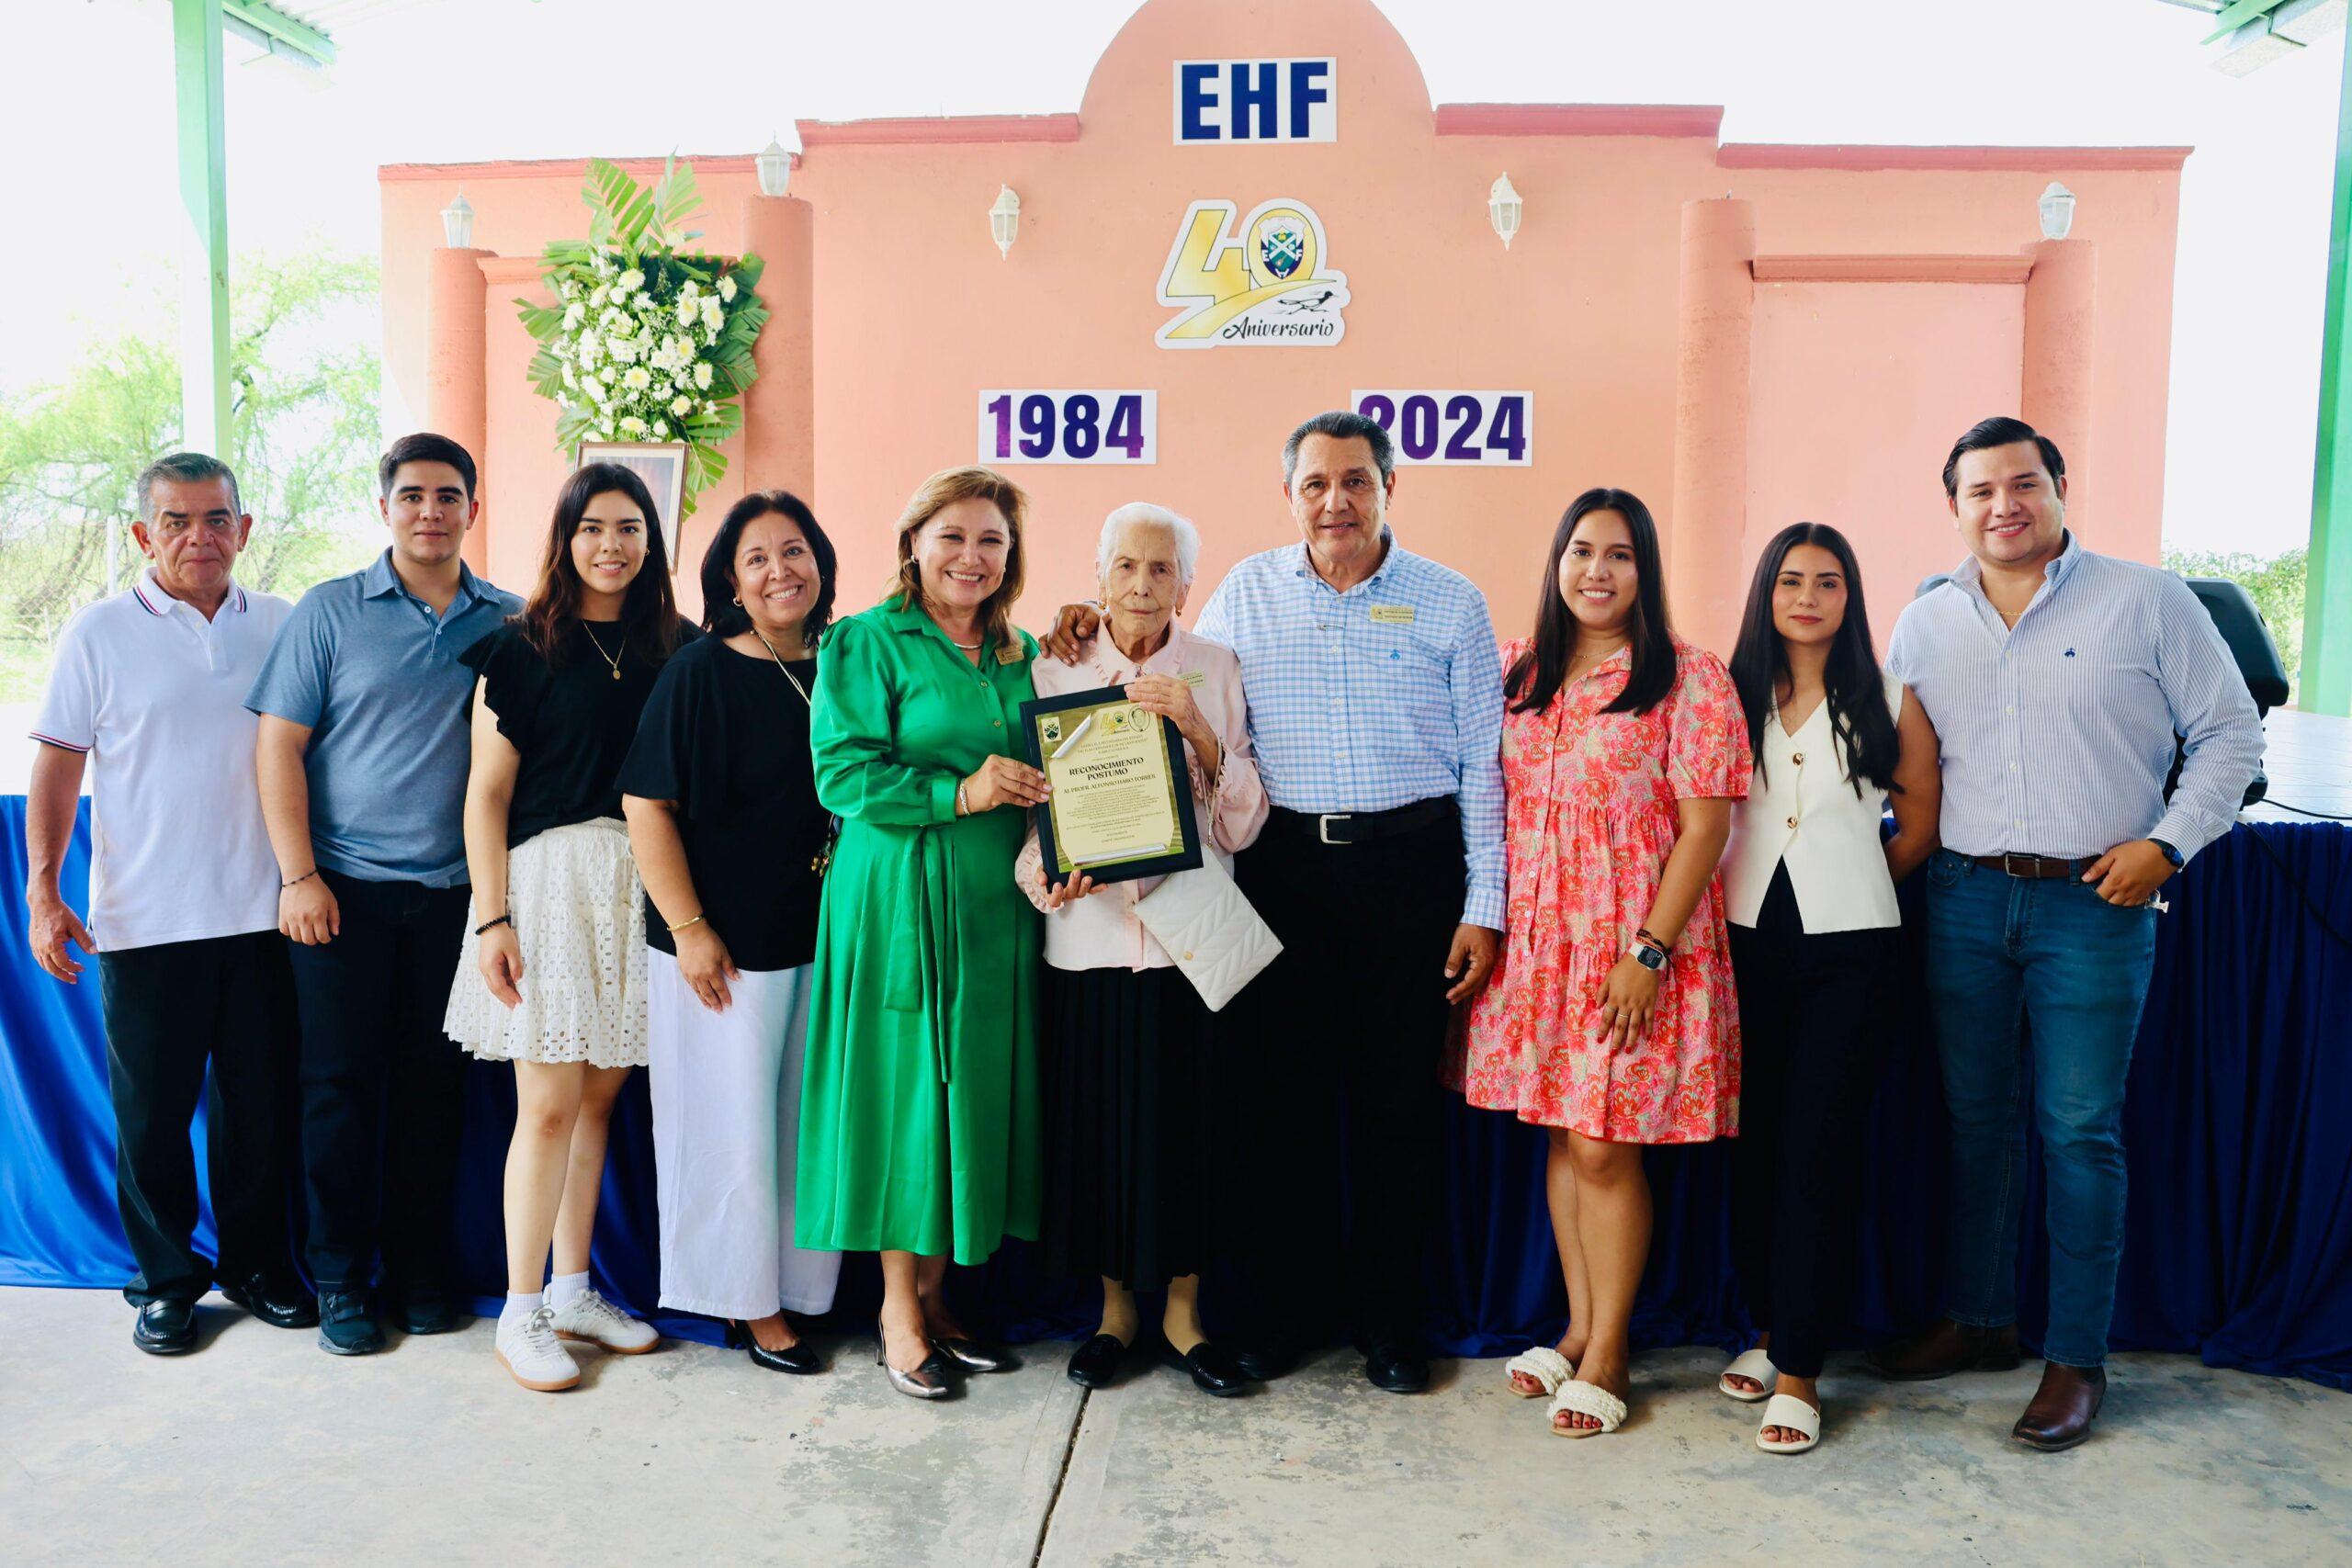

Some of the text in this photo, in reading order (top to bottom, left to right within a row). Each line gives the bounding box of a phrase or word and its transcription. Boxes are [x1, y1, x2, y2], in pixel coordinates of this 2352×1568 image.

[1182, 62, 1329, 140] EHF
[1165, 208, 1317, 307] 40
[1223, 316, 1334, 339] Aniversario
[988, 394, 1145, 458] 1984
[1069, 757, 1144, 776] RECONOCIMIENTO
[1087, 767, 1128, 781] POSTUMO
